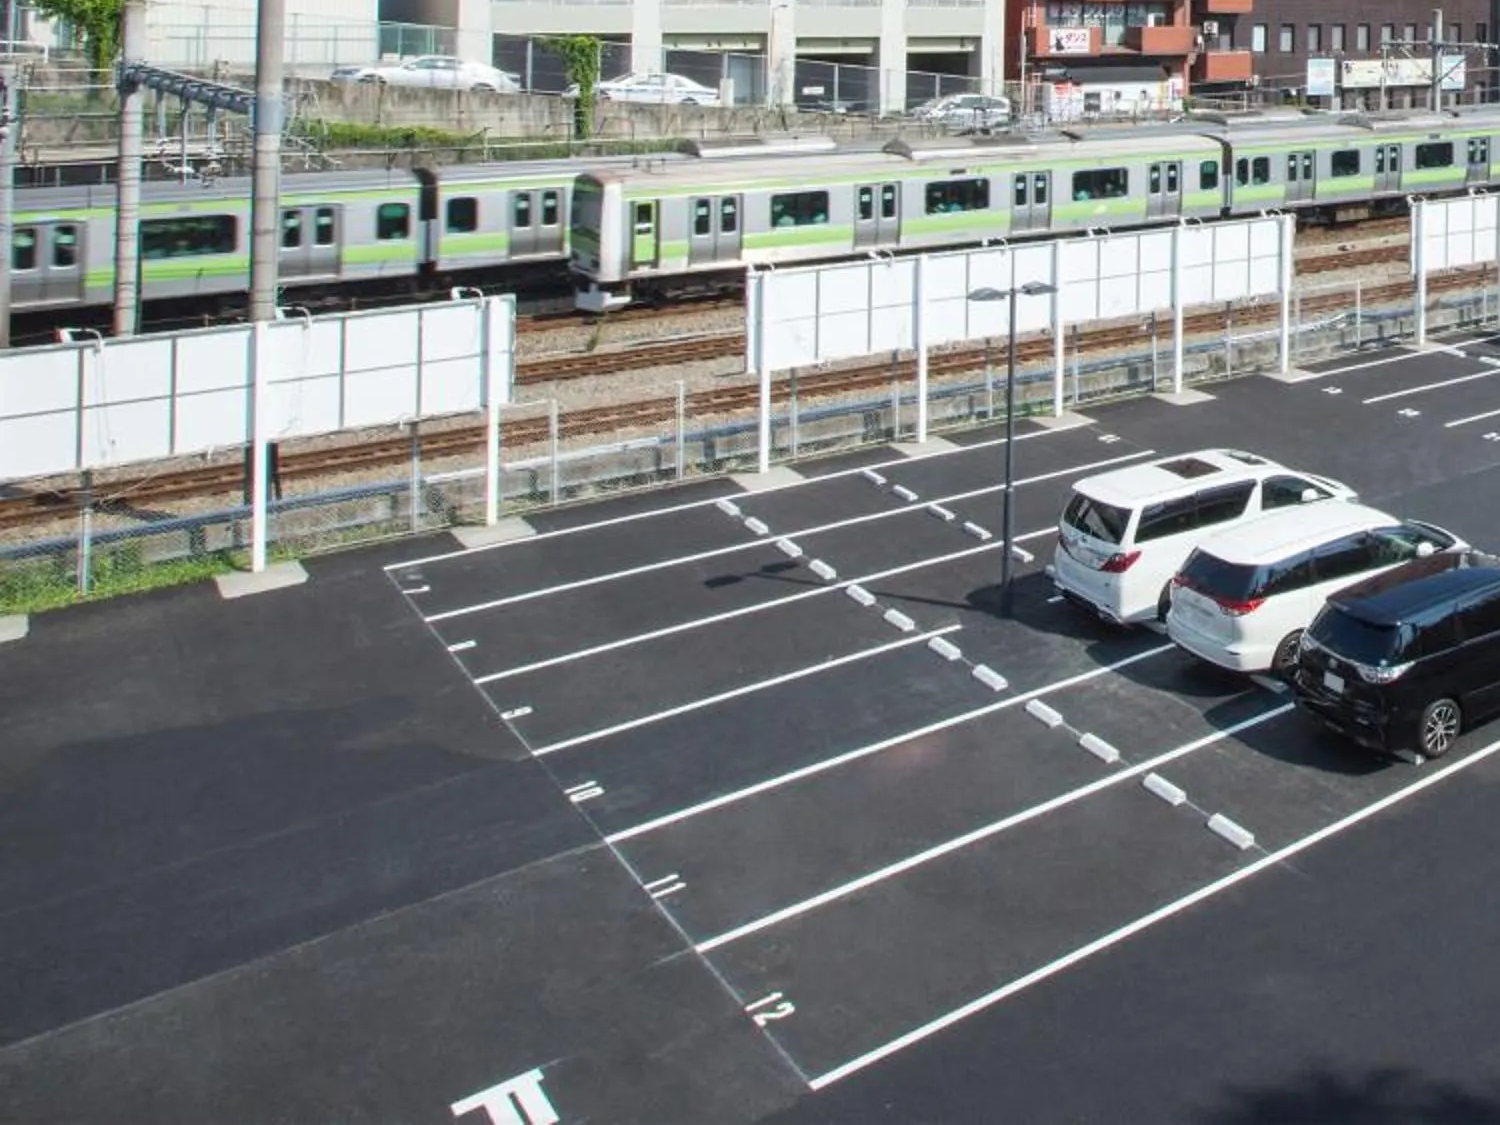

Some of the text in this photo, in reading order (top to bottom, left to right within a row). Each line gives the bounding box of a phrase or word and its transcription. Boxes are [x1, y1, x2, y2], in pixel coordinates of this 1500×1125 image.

[564, 780, 605, 803] 10
[644, 873, 687, 899] 11
[745, 991, 796, 1027] 12
